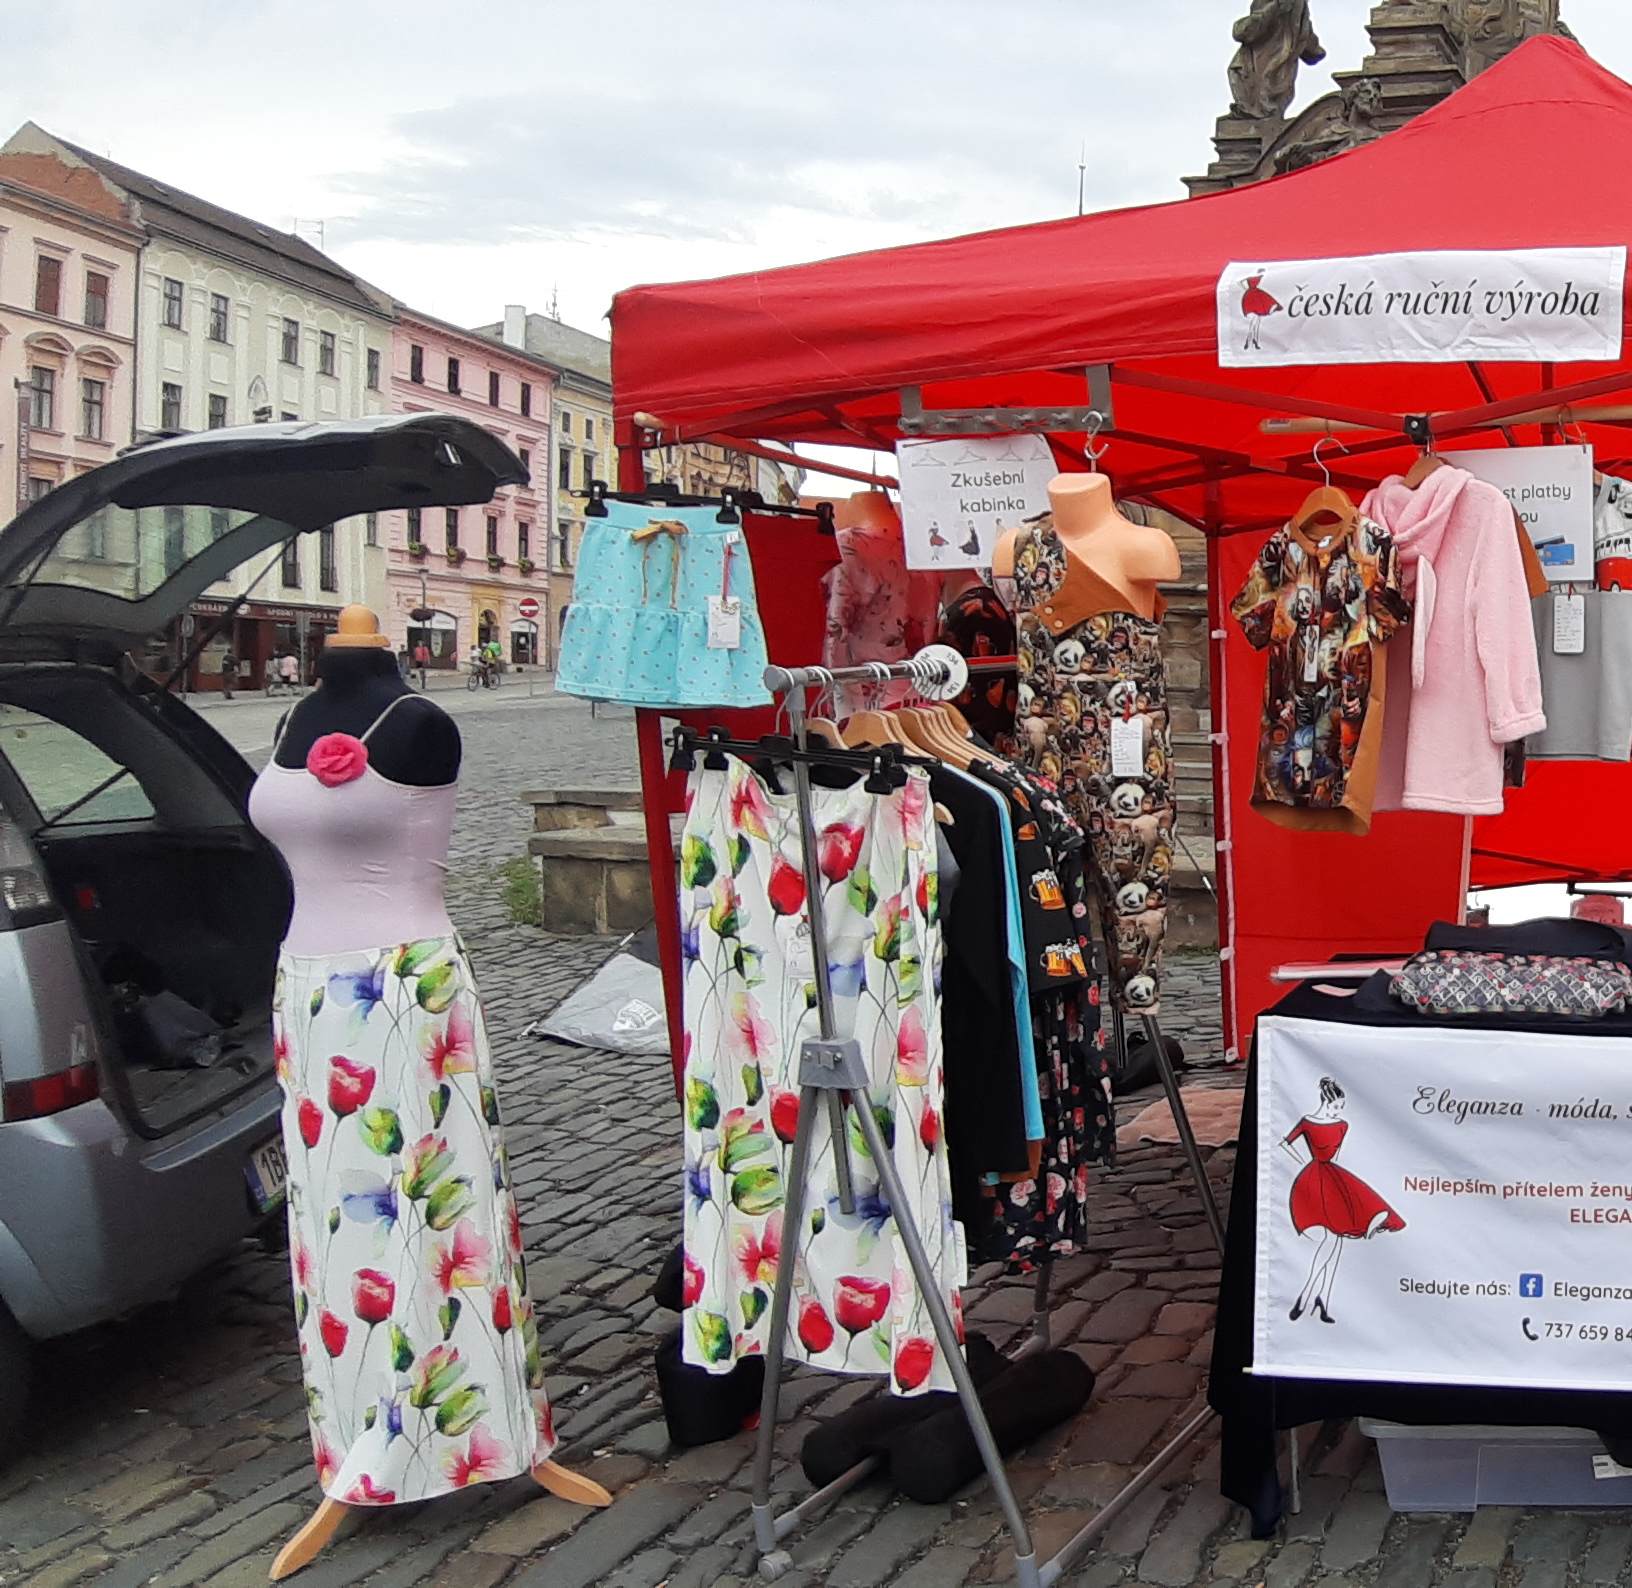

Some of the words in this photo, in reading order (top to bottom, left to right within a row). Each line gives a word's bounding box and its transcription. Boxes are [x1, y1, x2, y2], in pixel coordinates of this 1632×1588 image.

[1287, 280, 1375, 321] česká
[1384, 278, 1478, 319] ruční
[1484, 279, 1601, 323] výroba
[950, 468, 1025, 488] Zkušební
[1503, 486, 1517, 500] st
[1521, 483, 1572, 503] platby
[959, 496, 1026, 513] kabinka
[1520, 511, 1539, 523] ou
[1412, 1085, 1524, 1125] Eleganza
[1549, 1096, 1618, 1122] móda,
[1404, 1174, 1497, 1197] Nejlepším
[1502, 1179, 1584, 1200] přítelem
[1399, 1277, 1470, 1299] Sledujte
[1475, 1279, 1512, 1296] nás:
[1544, 1322, 1574, 1339] 737
[1578, 1324, 1609, 1341] 659
